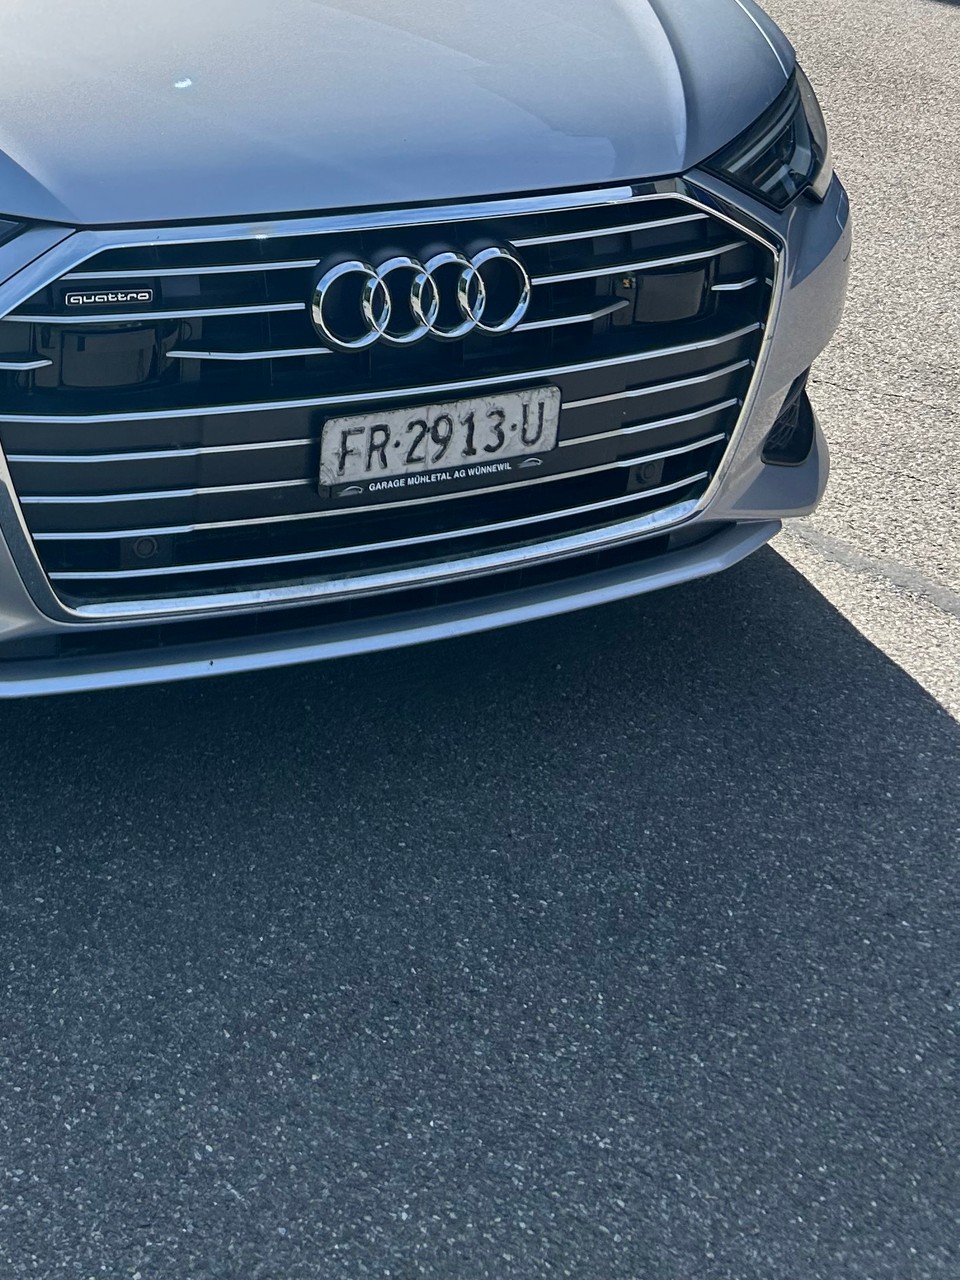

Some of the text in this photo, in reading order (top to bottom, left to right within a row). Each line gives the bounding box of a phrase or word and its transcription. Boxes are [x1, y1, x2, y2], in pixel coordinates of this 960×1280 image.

[70, 292, 149, 304] quattro
[368, 462, 512, 492] GARAGE MÜHLETAL AG WÜNNEWIL
